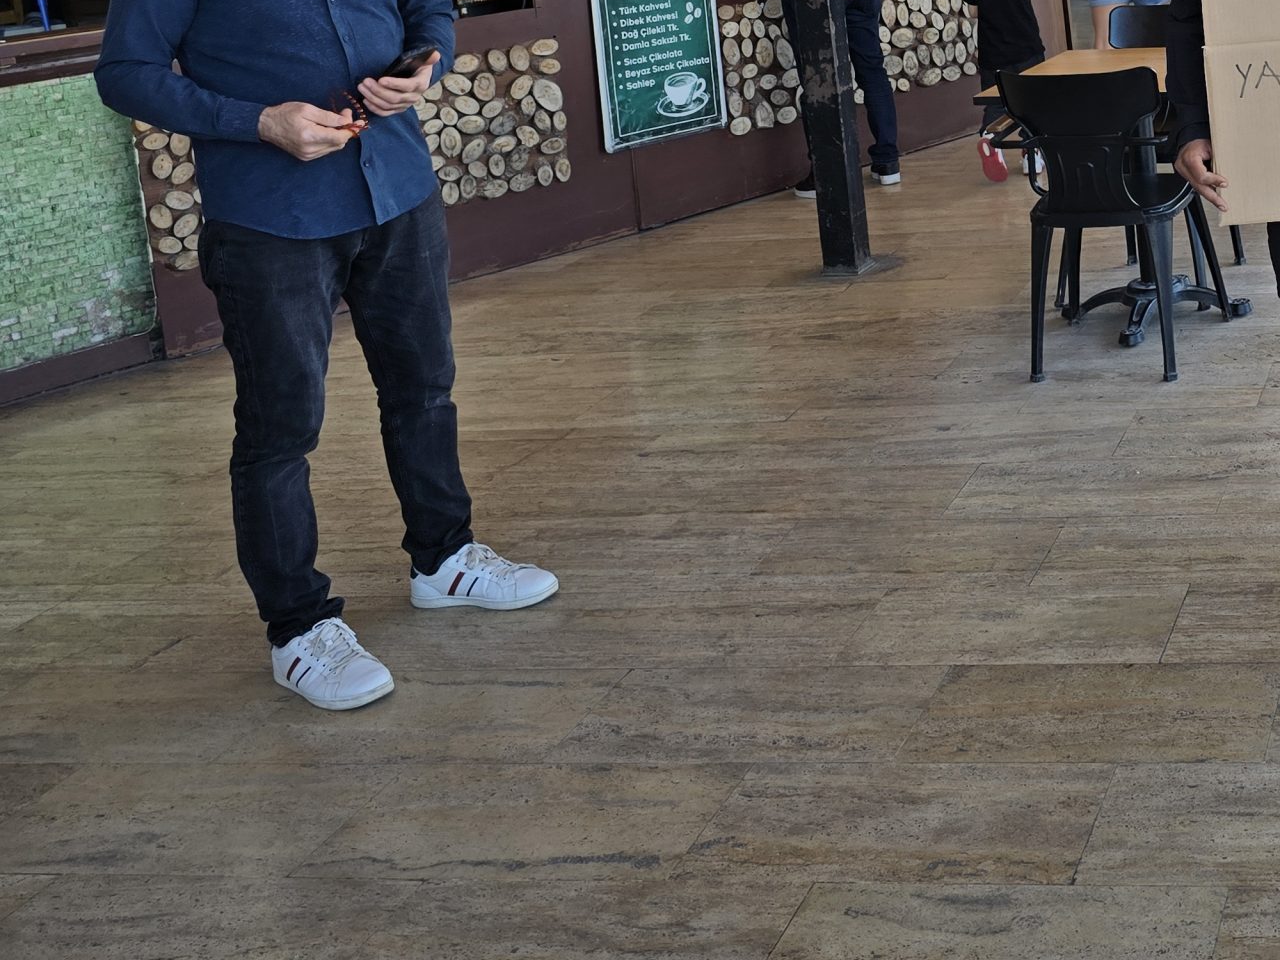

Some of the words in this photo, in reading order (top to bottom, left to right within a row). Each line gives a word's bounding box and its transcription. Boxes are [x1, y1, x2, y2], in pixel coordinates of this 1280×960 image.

[619, 6, 638, 16] Türk
[639, 0, 672, 10] Kahvesi
[620, 16, 645, 27] Dibek
[646, 11, 679, 23] Kahvesi
[621, 30, 639, 39] Dağ
[640, 25, 666, 37] Çilekli
[667, 23, 679, 31] Tk.
[622, 40, 650, 51] Damla
[651, 35, 678, 46] Sakızlı
[679, 33, 691, 41] Tk.
[623, 55, 648, 66] Sıcak
[649, 49, 683, 63] Çikolata
[625, 67, 651, 78] Beyaz
[652, 62, 675, 73] Sıcak
[676, 57, 710, 70] Çikolata
[626, 79, 655, 90] Sahlep
